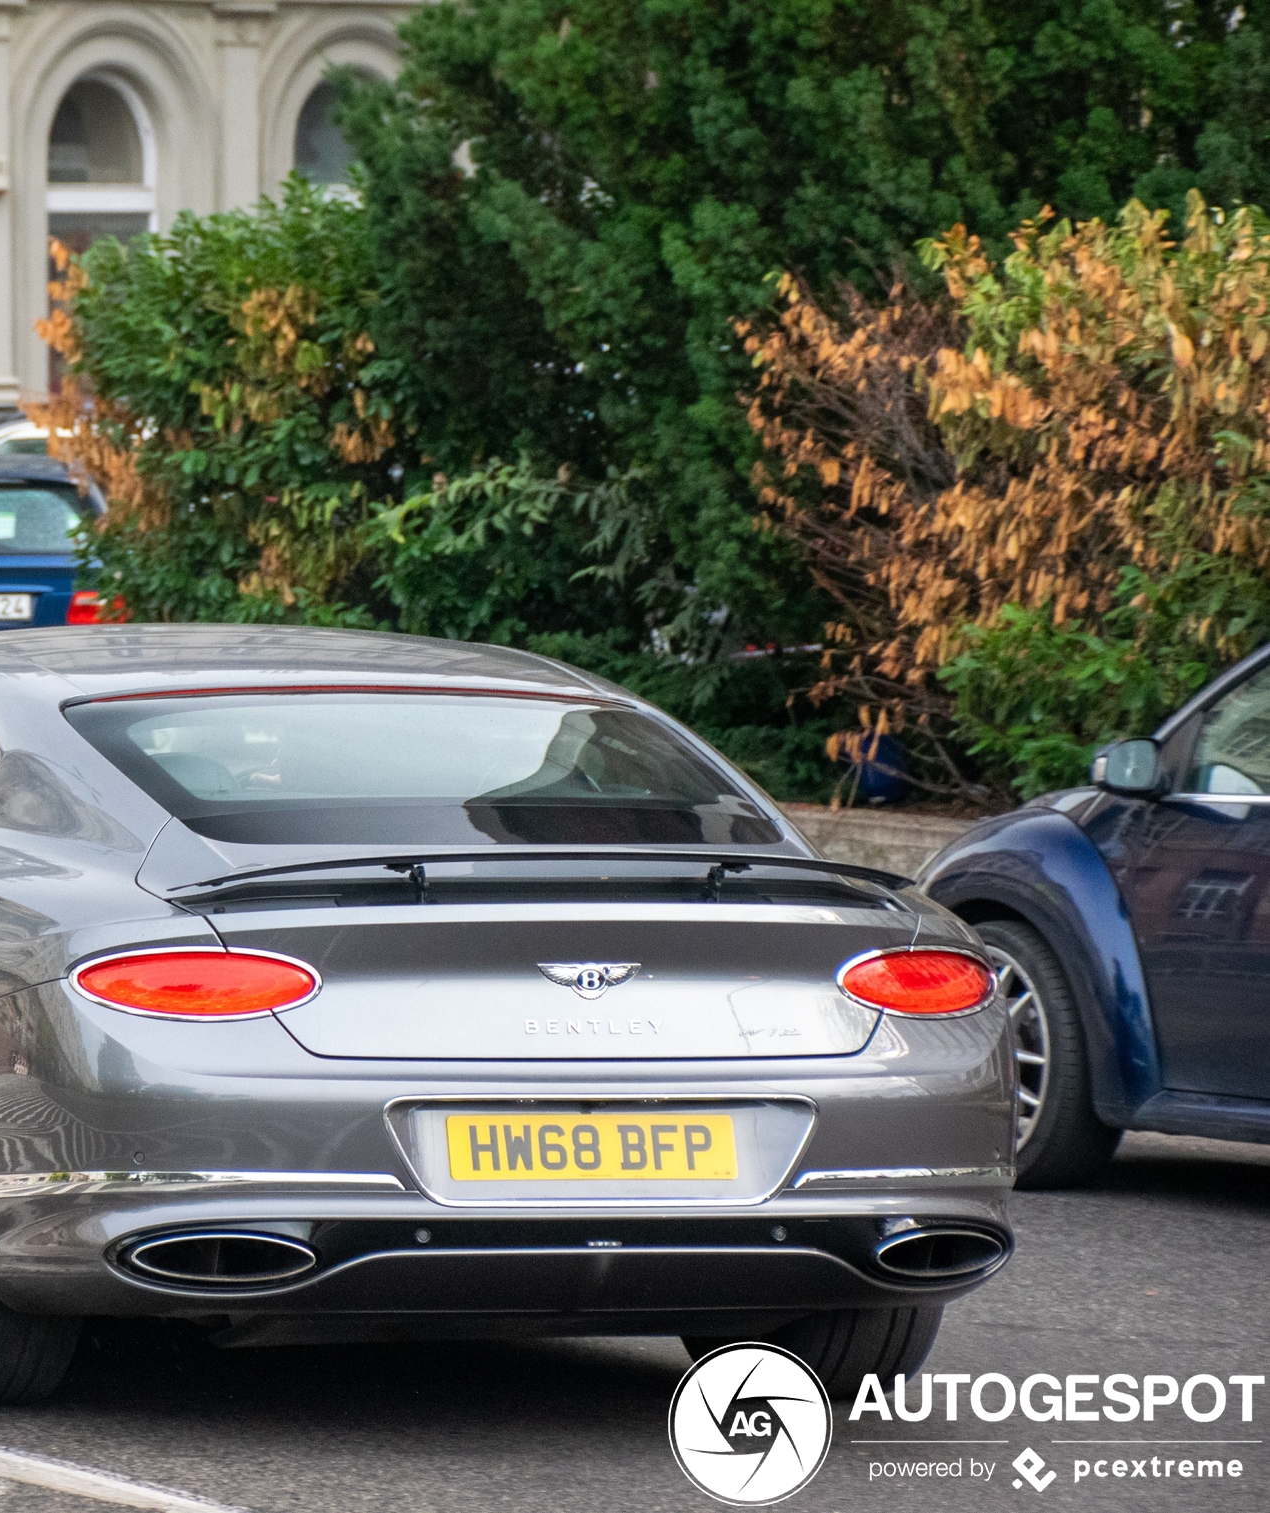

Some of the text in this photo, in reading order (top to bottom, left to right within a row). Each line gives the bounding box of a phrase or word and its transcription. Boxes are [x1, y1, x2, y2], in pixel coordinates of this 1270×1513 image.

[525, 1019, 664, 1035] BENTLEY
[468, 1123, 713, 1172] HW68 BFP
